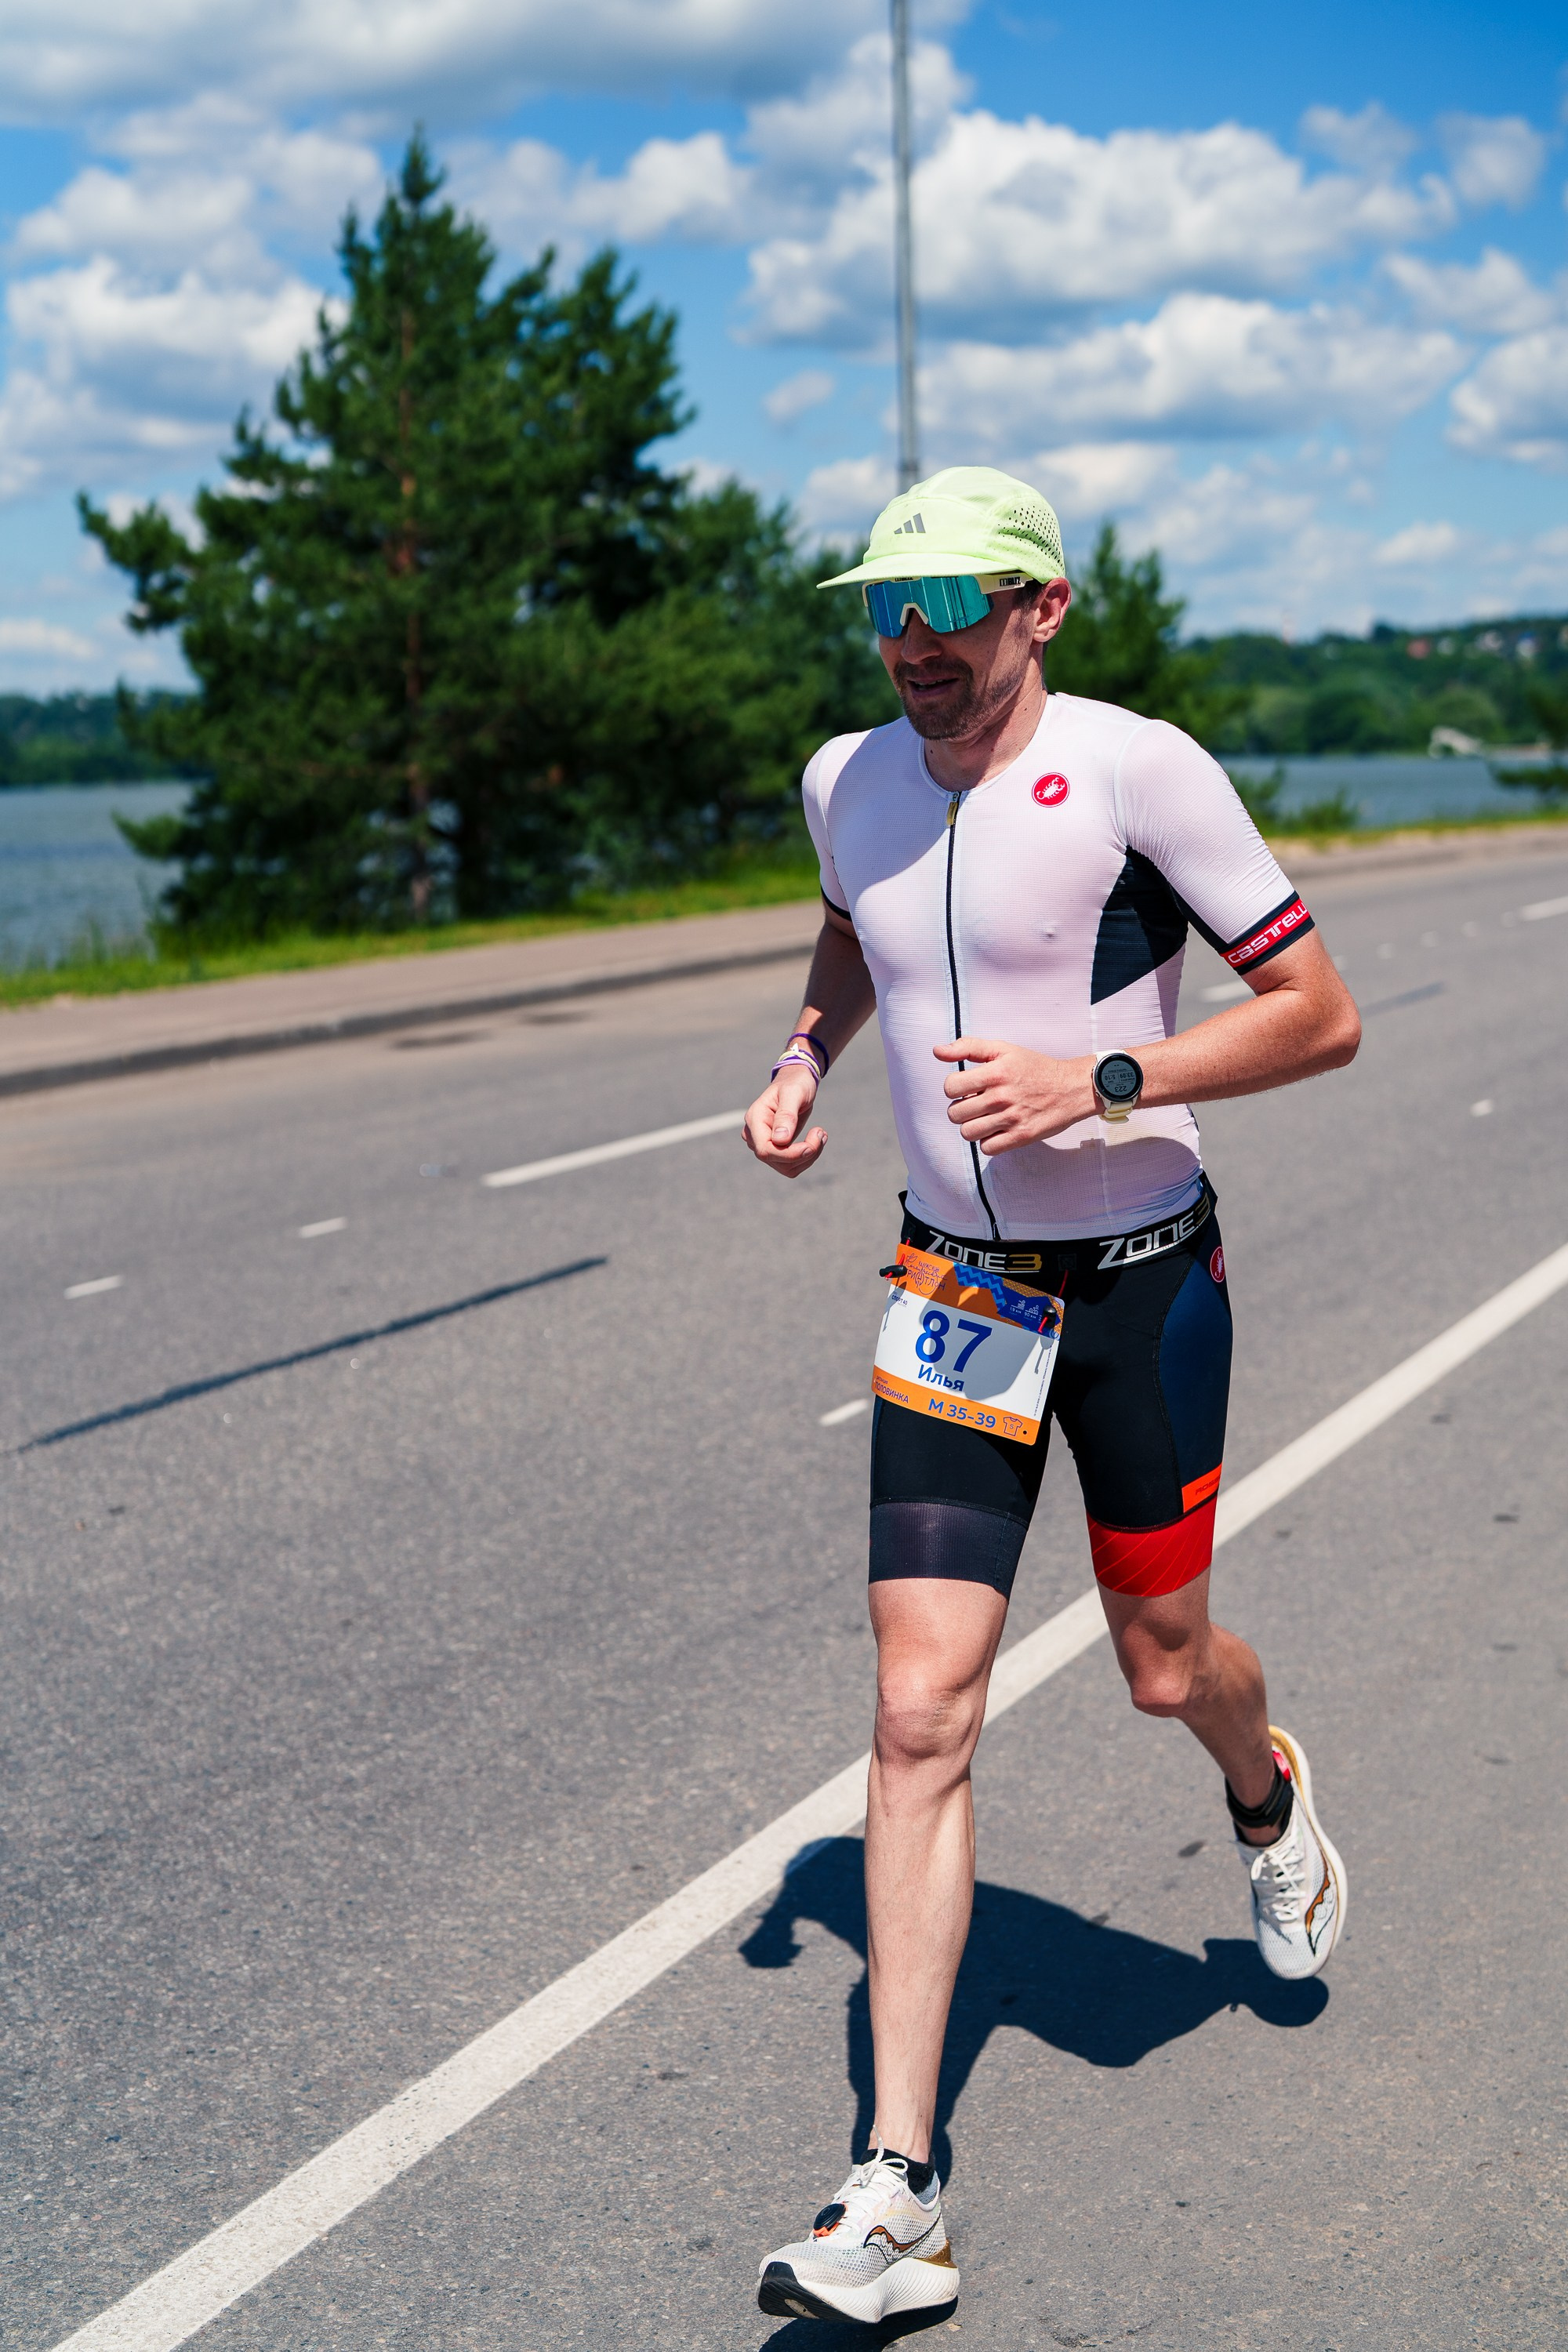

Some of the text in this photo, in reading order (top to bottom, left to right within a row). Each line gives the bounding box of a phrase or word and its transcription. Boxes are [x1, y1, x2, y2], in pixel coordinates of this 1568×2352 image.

[1098, 1192, 1211, 1270] ZONE3
[925, 1230, 1043, 1273] ZONE3
[915, 1309, 993, 1373] 87
[875, 1381, 909, 1403] ПОЛОВИНКА
[918, 1364, 964, 1392] Илья
[946, 1404, 996, 1428] 35-39
